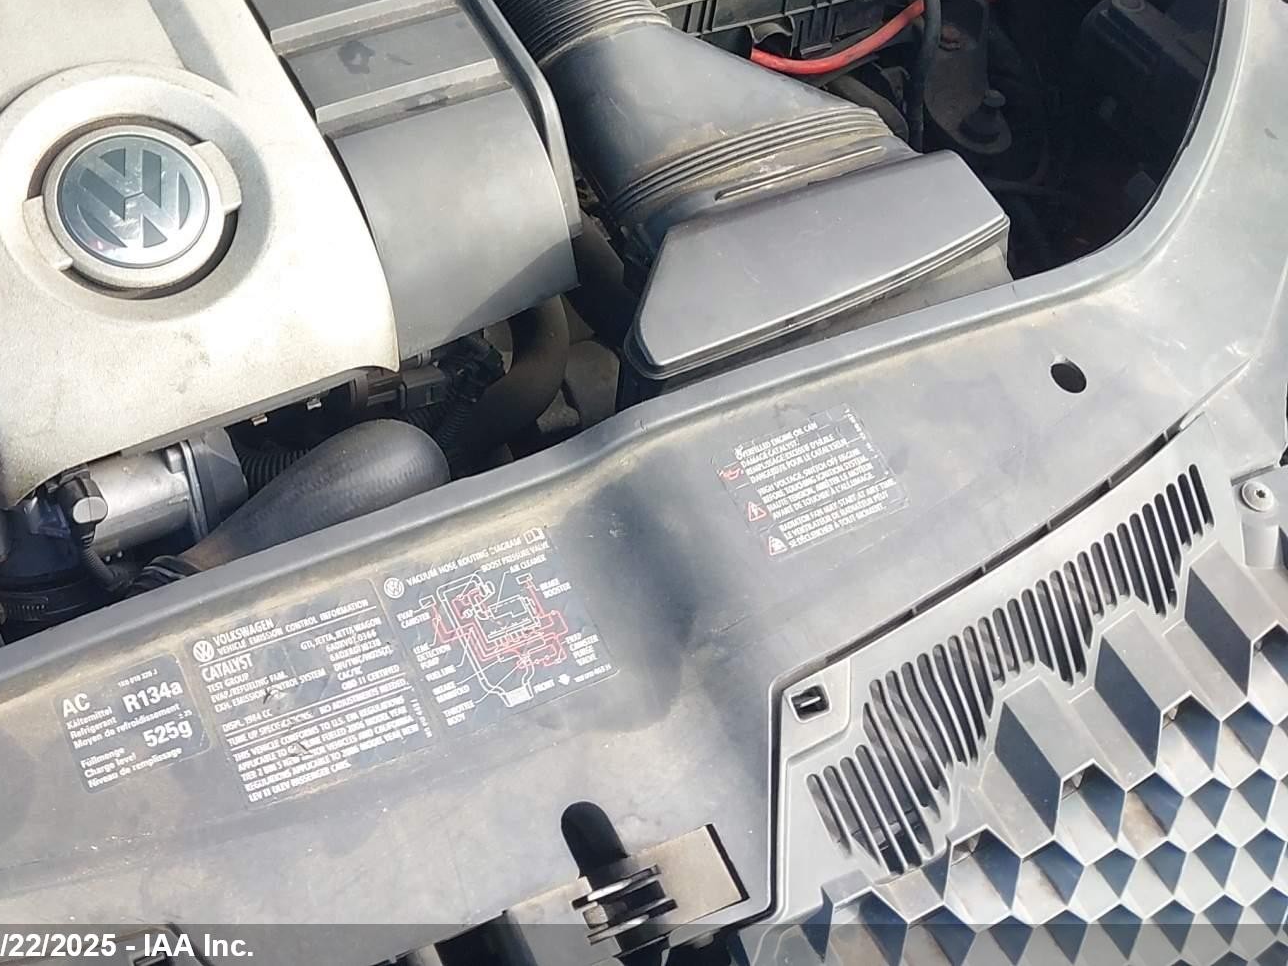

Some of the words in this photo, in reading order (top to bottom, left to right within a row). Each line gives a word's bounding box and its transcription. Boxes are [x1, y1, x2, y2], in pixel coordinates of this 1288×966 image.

[405, 568, 438, 586] VACUUM
[437, 560, 458, 574] HOSE
[457, 548, 489, 566] ROUTING
[212, 618, 273, 646] VOLKSWAGEN
[217, 639, 247, 655] VEHICLE
[248, 627, 283, 645] EMISSION
[285, 616, 317, 632] CONTROL
[319, 599, 368, 620] INFORMATION
[201, 653, 252, 681] CATALYST
[206, 681, 223, 693] TEST
[224, 672, 249, 687] GROUP
[231, 689, 266, 706] EMISSION
[299, 668, 326, 683] SYSTEM
[63, 693, 90, 717] AC
[123, 682, 183, 712] R134a
[66, 706, 112, 729] Kältemittel
[70, 716, 117, 739] Refrigerant
[73, 733, 103, 749] Moyen
[104, 728, 116, 737] de
[116, 703, 180, 732] refroidissement
[143, 717, 192, 746] 525g
[233, 749, 251, 761] THIS
[250, 739, 280, 755] VEHICLE
[280, 725, 319, 745] CONFORMS
[319, 721, 331, 731] TO
[80, 747, 125, 768] Füllmenge
[84, 762, 115, 778] Charge
[115, 752, 136, 766] level
[87, 772, 118, 787] Niveau
[119, 767, 131, 776] de
[132, 747, 182, 770] remplissage
[238, 751, 277, 771] APPLICABLE
